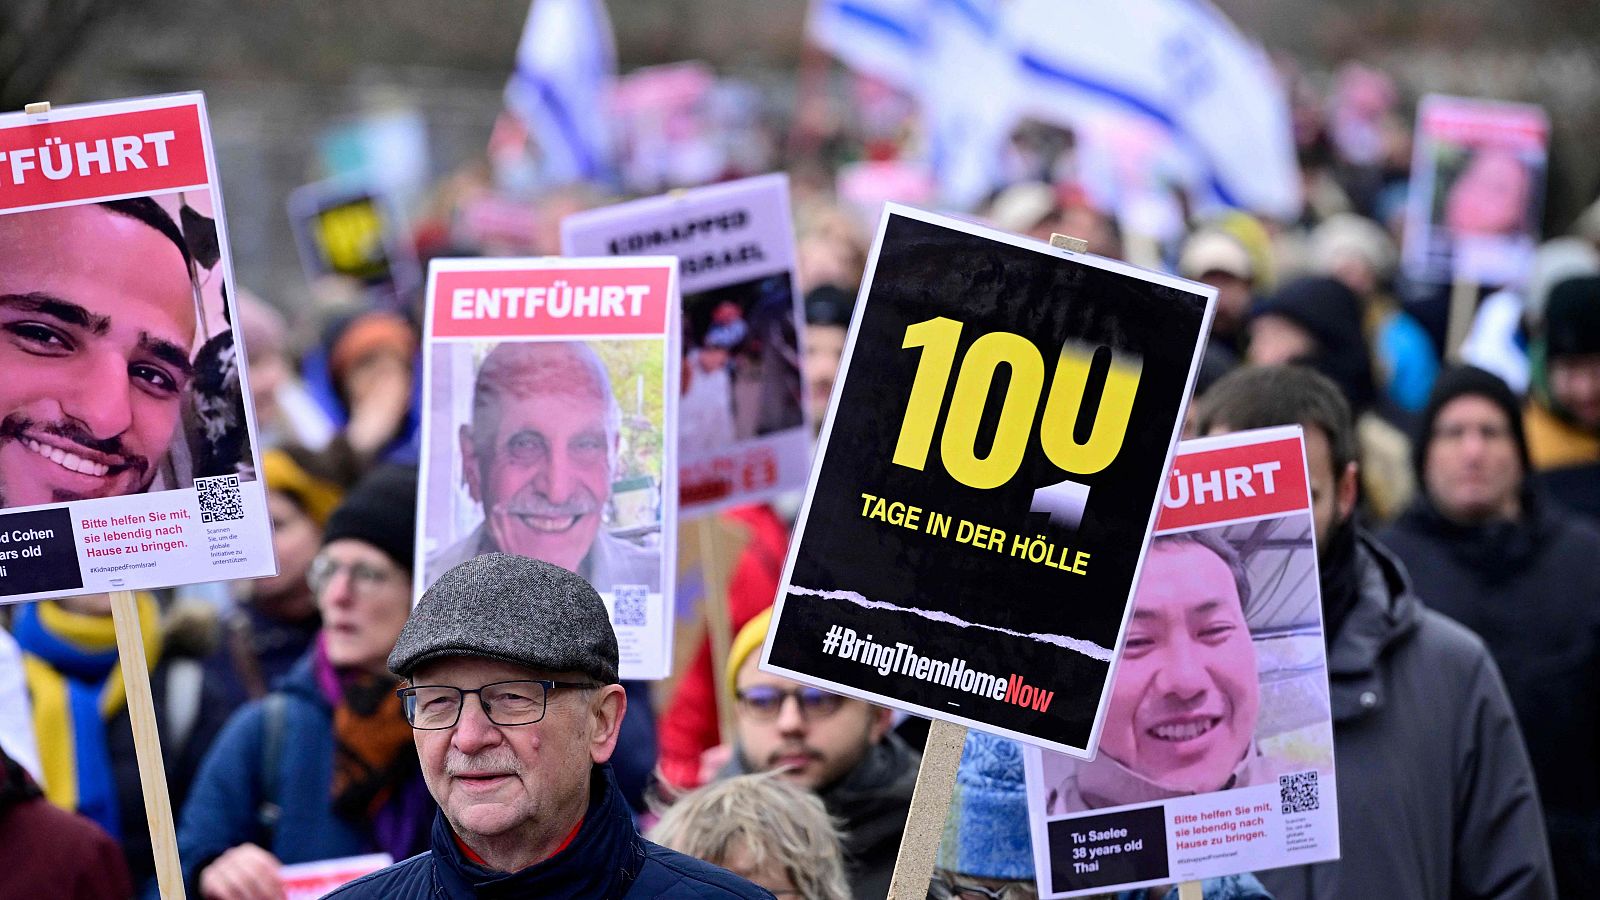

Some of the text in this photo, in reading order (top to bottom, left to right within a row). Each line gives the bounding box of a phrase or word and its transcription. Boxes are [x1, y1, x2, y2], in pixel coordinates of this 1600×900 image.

[0, 130, 175, 185] FÜHRT
[451, 280, 650, 320] ENTFÜHRT
[892, 316, 1144, 489] 100
[81, 509, 191, 529] Bitte helfen Sie mit,
[12, 529, 54, 542] Cohen
[84, 524, 183, 543] sie lebendig nach
[861, 493, 1091, 576] TAGE IN DER HÖLLE
[21, 545, 42, 558] old
[86, 540, 188, 557] Hause zu bringen.
[90, 561, 157, 573] #KidnappedFromIsrael
[822, 624, 1054, 713] #BringThemHomeNow
[1174, 815, 1198, 825] Bitte
[1200, 810, 1232, 821] helfen
[1235, 806, 1251, 816] Sie
[1071, 828, 1128, 844] Tu Saelee
[1175, 817, 1264, 837] sie lebendig nach
[1072, 838, 1143, 860] 38 years old
[1176, 839, 1208, 850] Hause
[1211, 838, 1223, 846] zu
[1073, 860, 1099, 874] Thai
